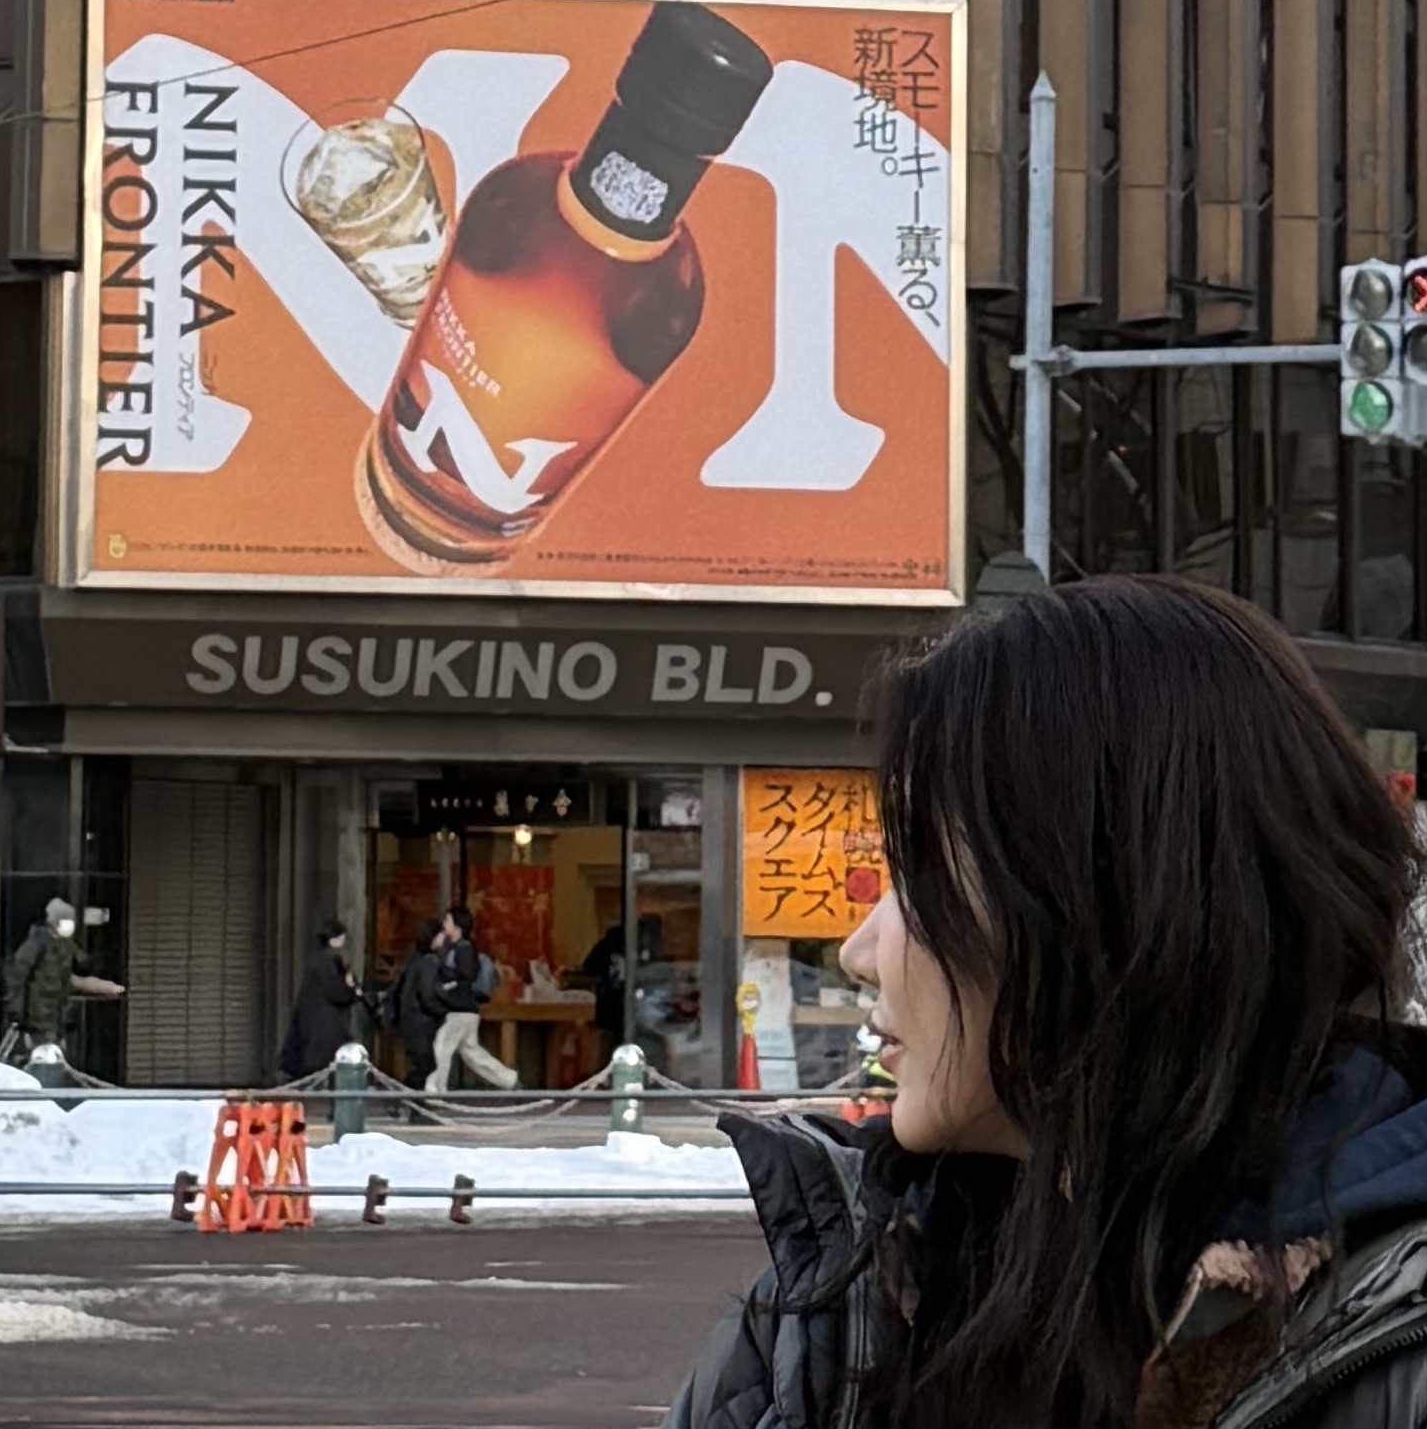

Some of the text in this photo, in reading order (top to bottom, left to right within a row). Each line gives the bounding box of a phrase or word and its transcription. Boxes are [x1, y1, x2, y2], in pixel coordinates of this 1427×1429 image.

[853, 27, 899, 177] 新境地。
[180, 81, 240, 338] NIKKA
[895, 29, 941, 328] スモーキー薫る、
[96, 80, 160, 469] FRONTIER
[185, 633, 834, 706] SUSUKINO BLD.
[759, 783, 797, 921] スクエア
[801, 782, 843, 918] タイムス
